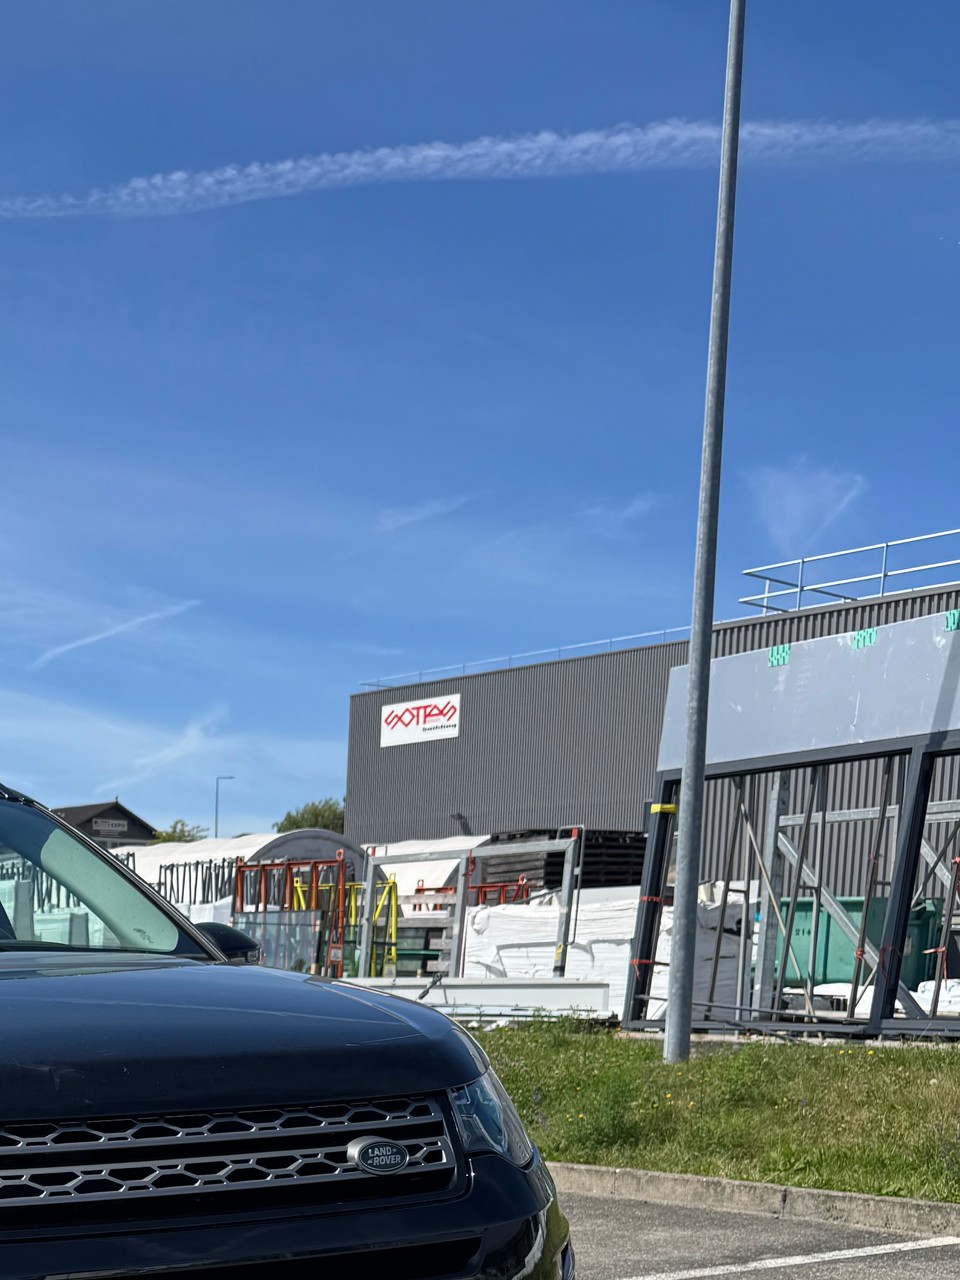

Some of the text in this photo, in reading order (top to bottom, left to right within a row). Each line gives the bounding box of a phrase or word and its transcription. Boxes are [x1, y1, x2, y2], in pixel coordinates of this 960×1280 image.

[384, 701, 457, 730] SOTTAS
[368, 1146, 392, 1157] LAND
[373, 1154, 401, 1166] ROVER
